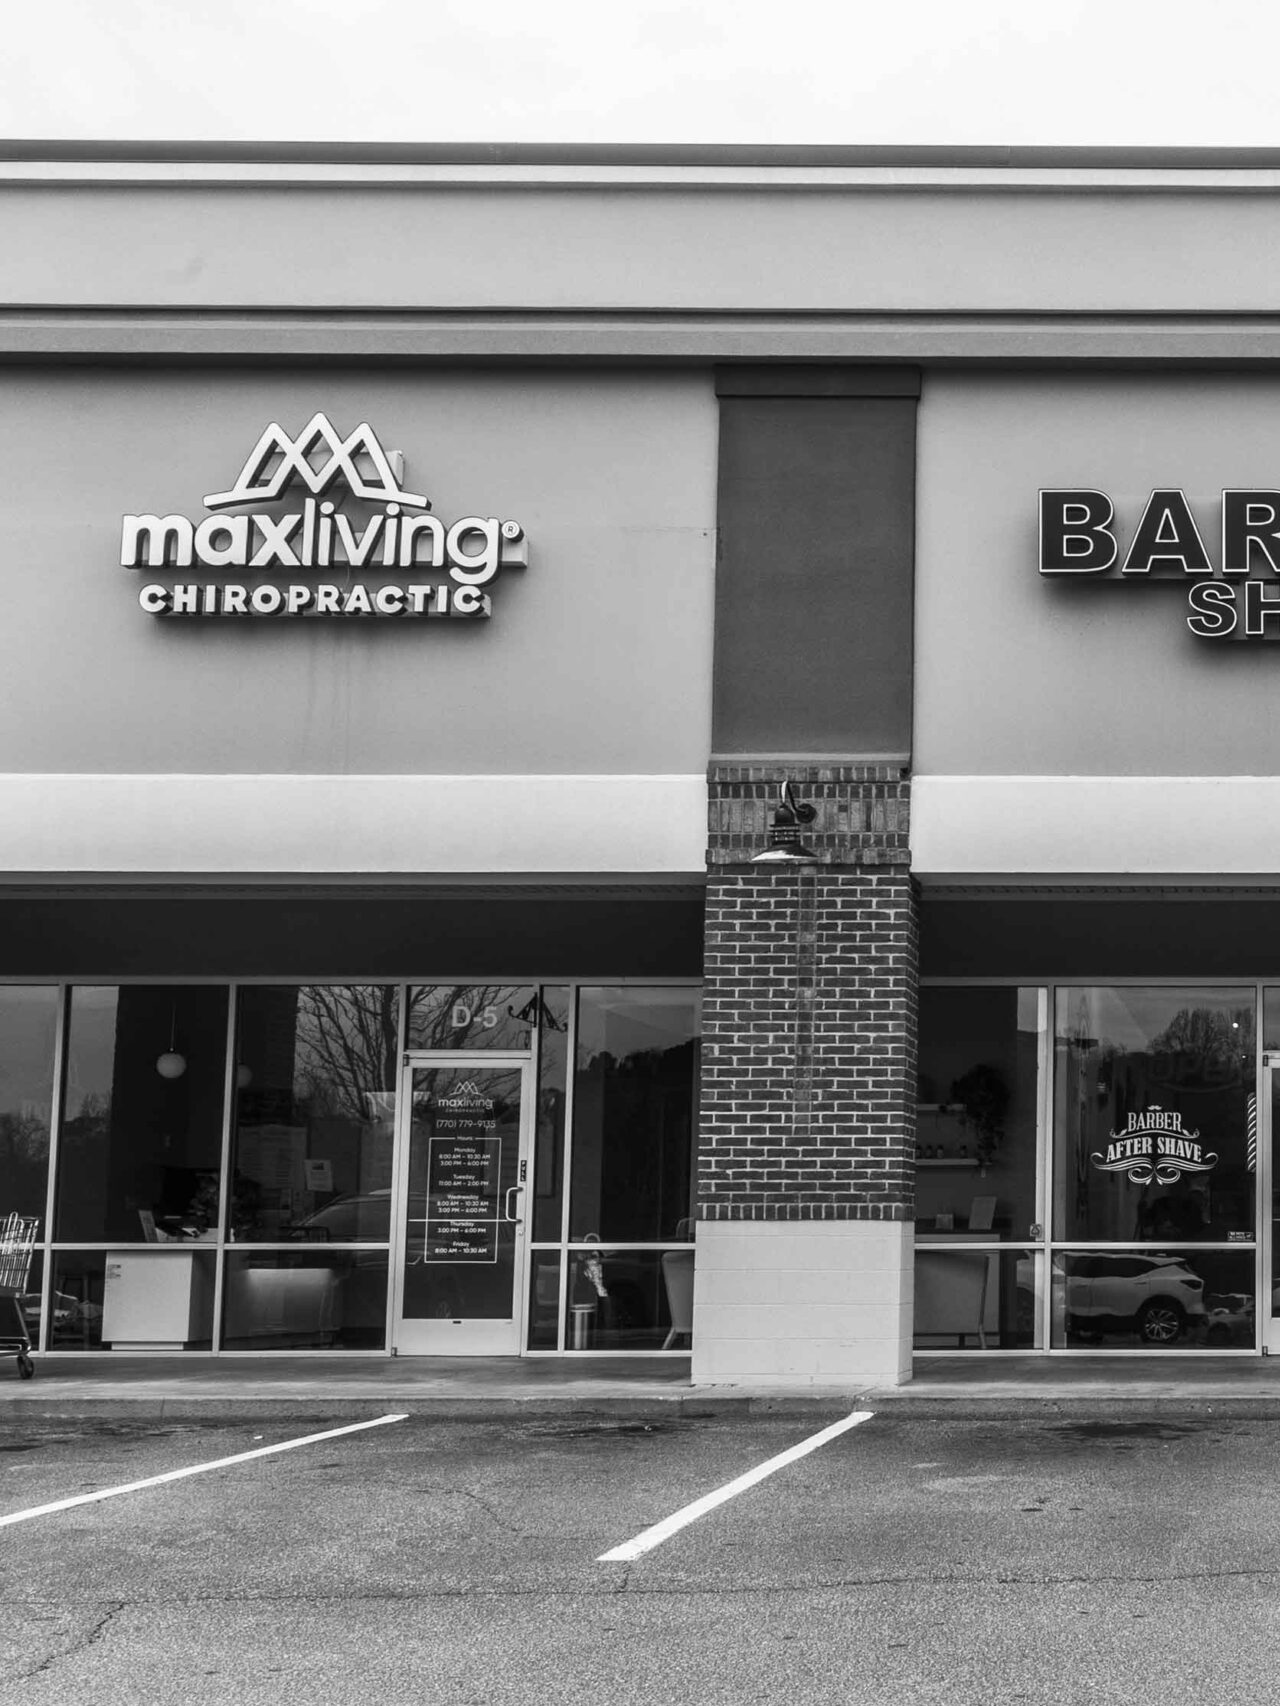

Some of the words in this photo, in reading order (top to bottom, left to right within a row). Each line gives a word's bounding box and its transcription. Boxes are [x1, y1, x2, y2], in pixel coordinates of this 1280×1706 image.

[139, 584, 486, 614] CHIROPRACTIC
[452, 1005, 498, 1028] D-5
[438, 1096, 494, 1110] maxliving
[436, 1119, 457, 1129] (770)
[1127, 1111, 1182, 1132] BARBER
[1106, 1137, 1153, 1163] AFTER
[1157, 1137, 1202, 1163] SHAVE
